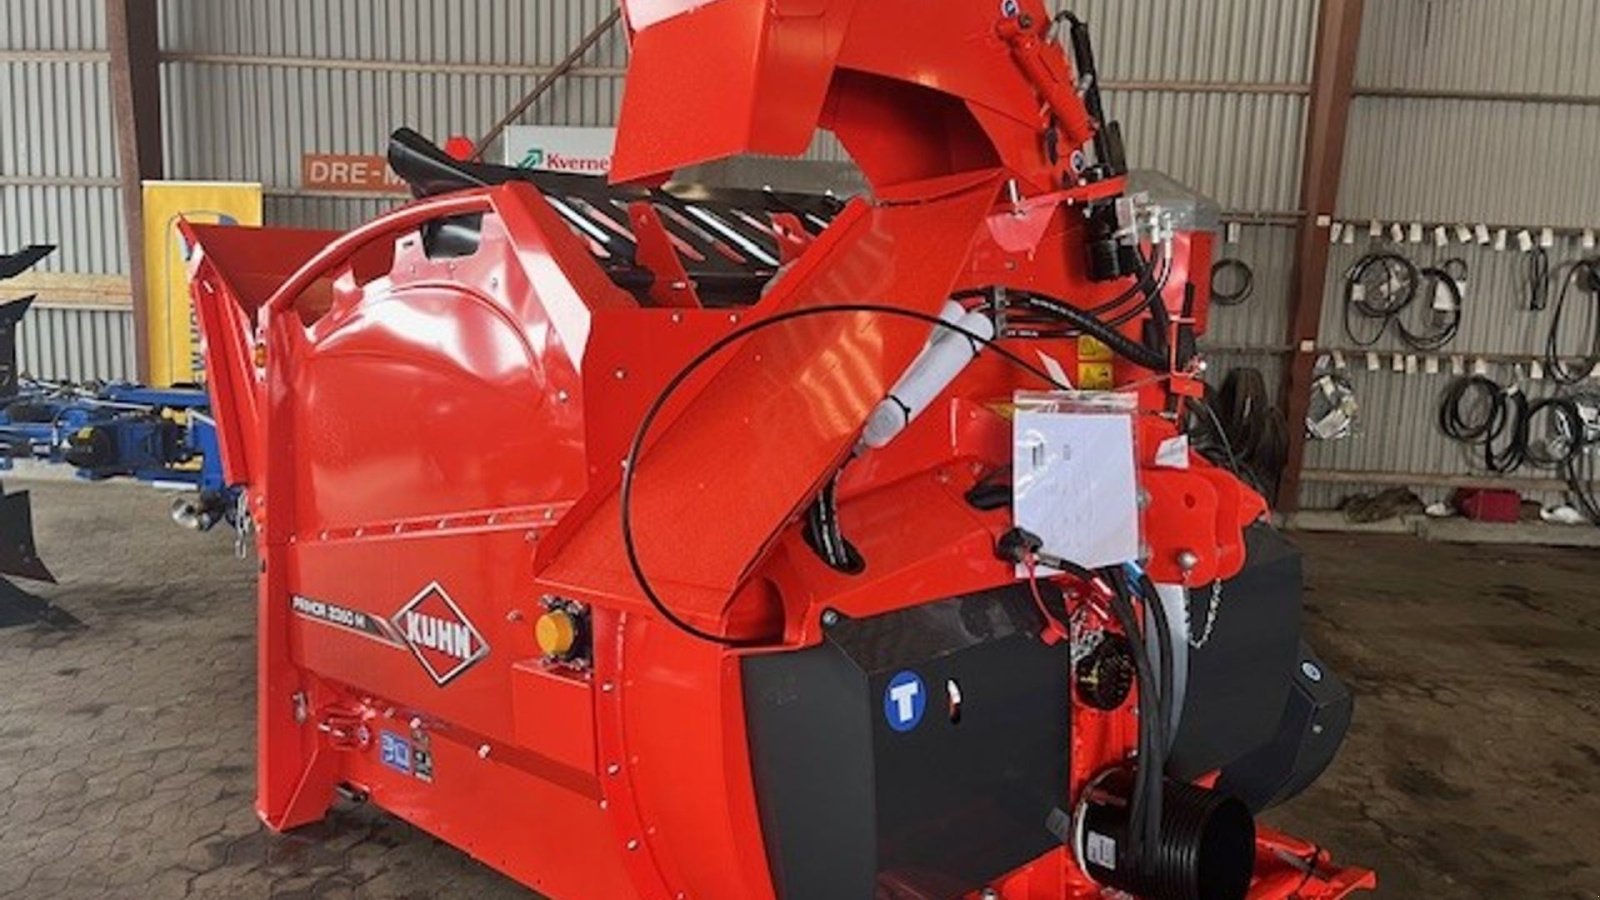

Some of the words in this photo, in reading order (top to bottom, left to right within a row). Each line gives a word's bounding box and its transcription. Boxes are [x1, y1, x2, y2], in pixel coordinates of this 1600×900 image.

[546, 153, 609, 171] Kverne
[406, 610, 471, 661] KUHN
[890, 681, 919, 722] T
